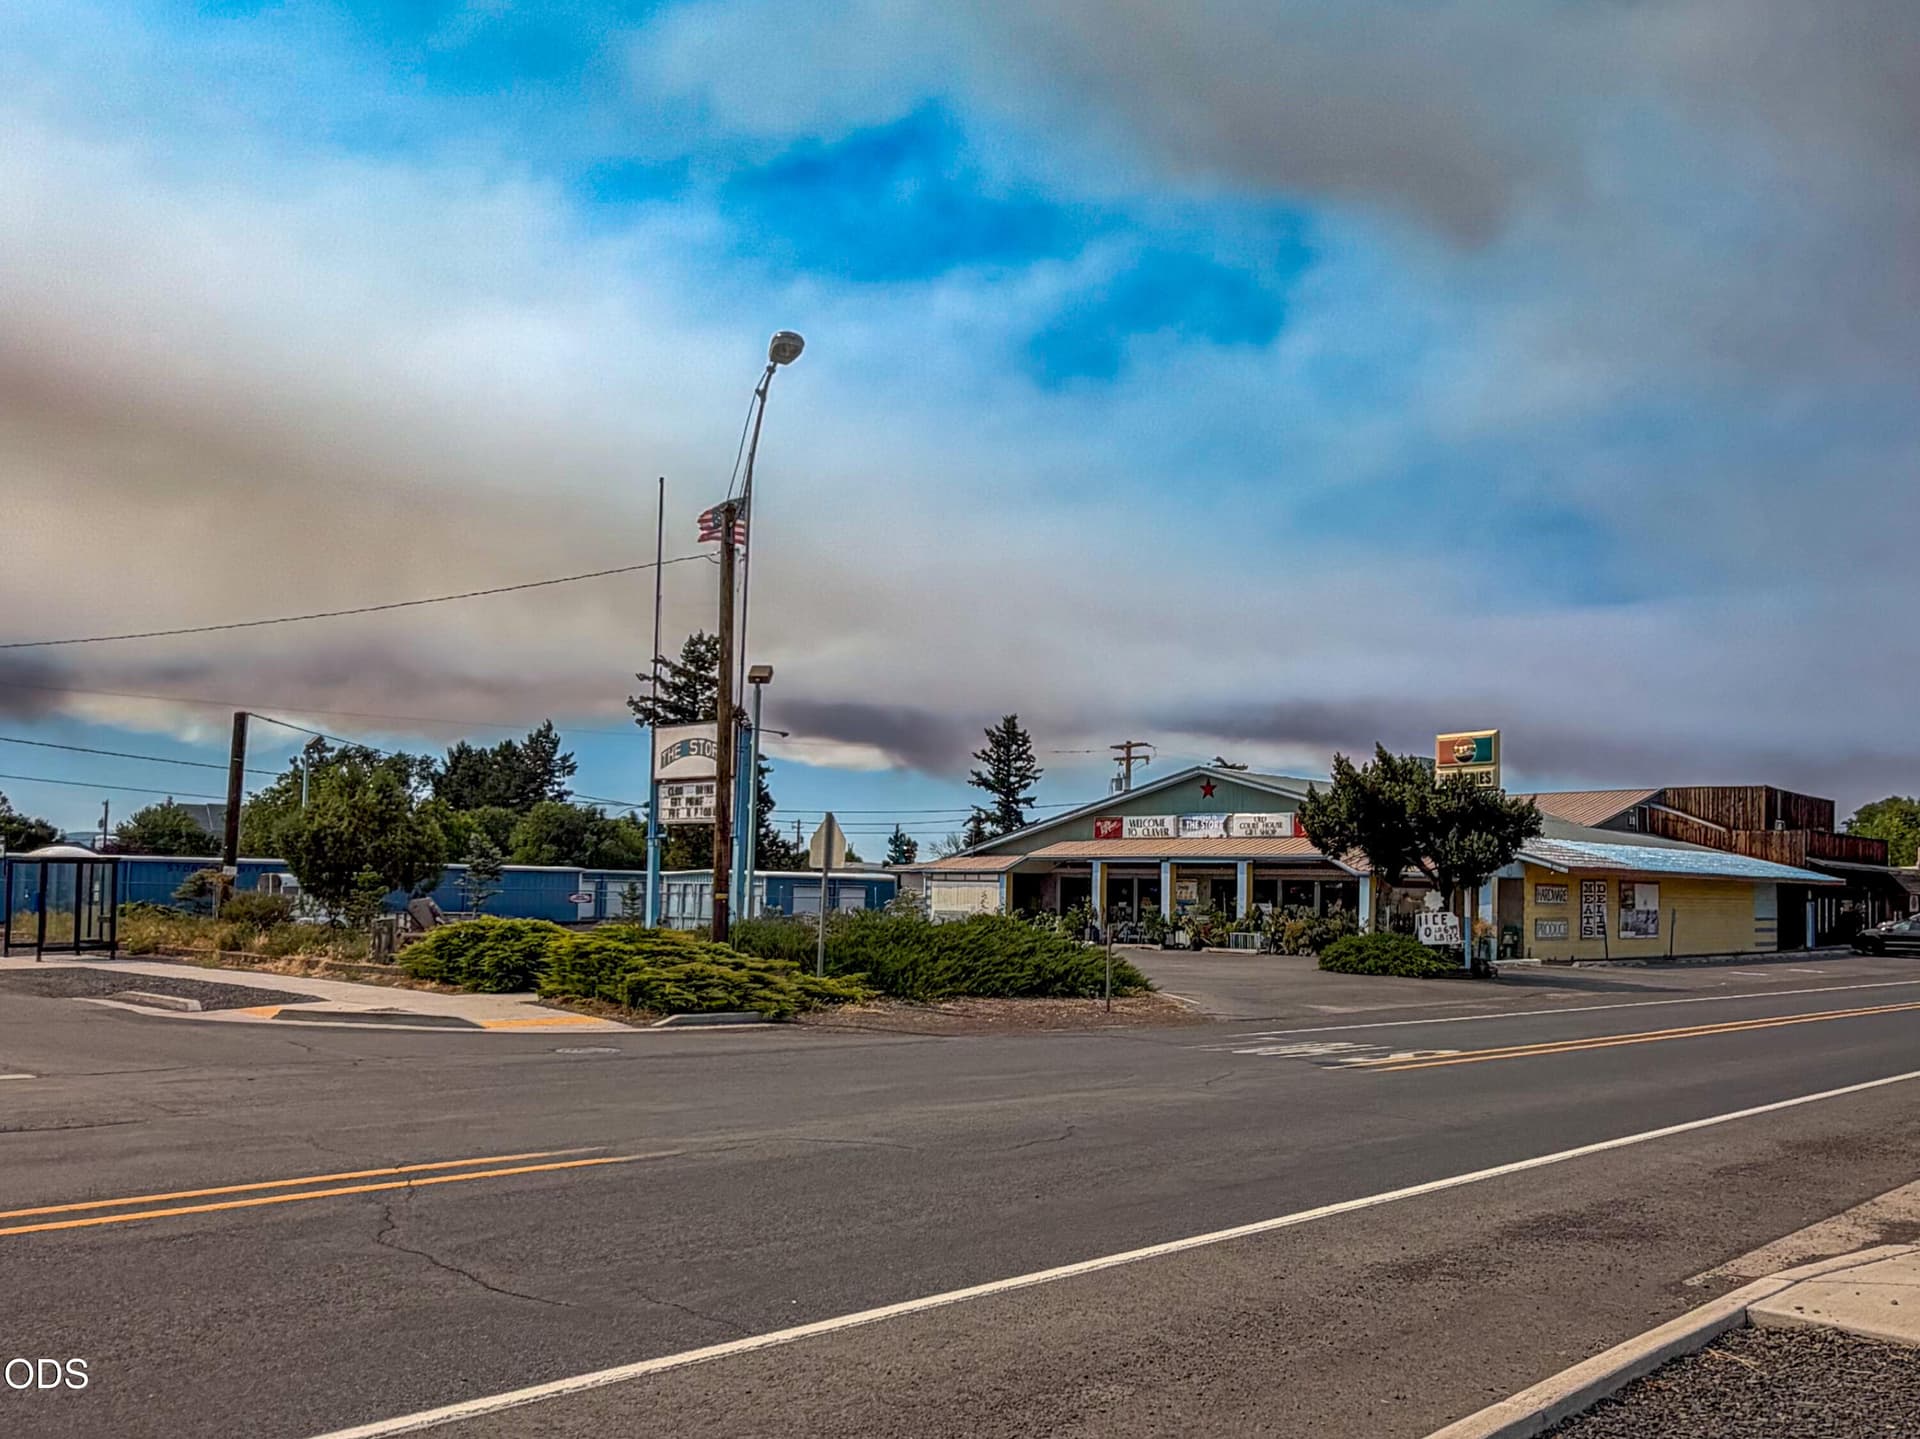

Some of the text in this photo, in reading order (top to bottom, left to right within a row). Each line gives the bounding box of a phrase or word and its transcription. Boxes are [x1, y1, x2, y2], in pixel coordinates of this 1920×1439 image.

[661, 739, 718, 766] THE STOR
[1128, 818, 1166, 828] WELCOME
[1127, 828, 1138, 837] TO
[1583, 883, 1594, 936] MEATS
